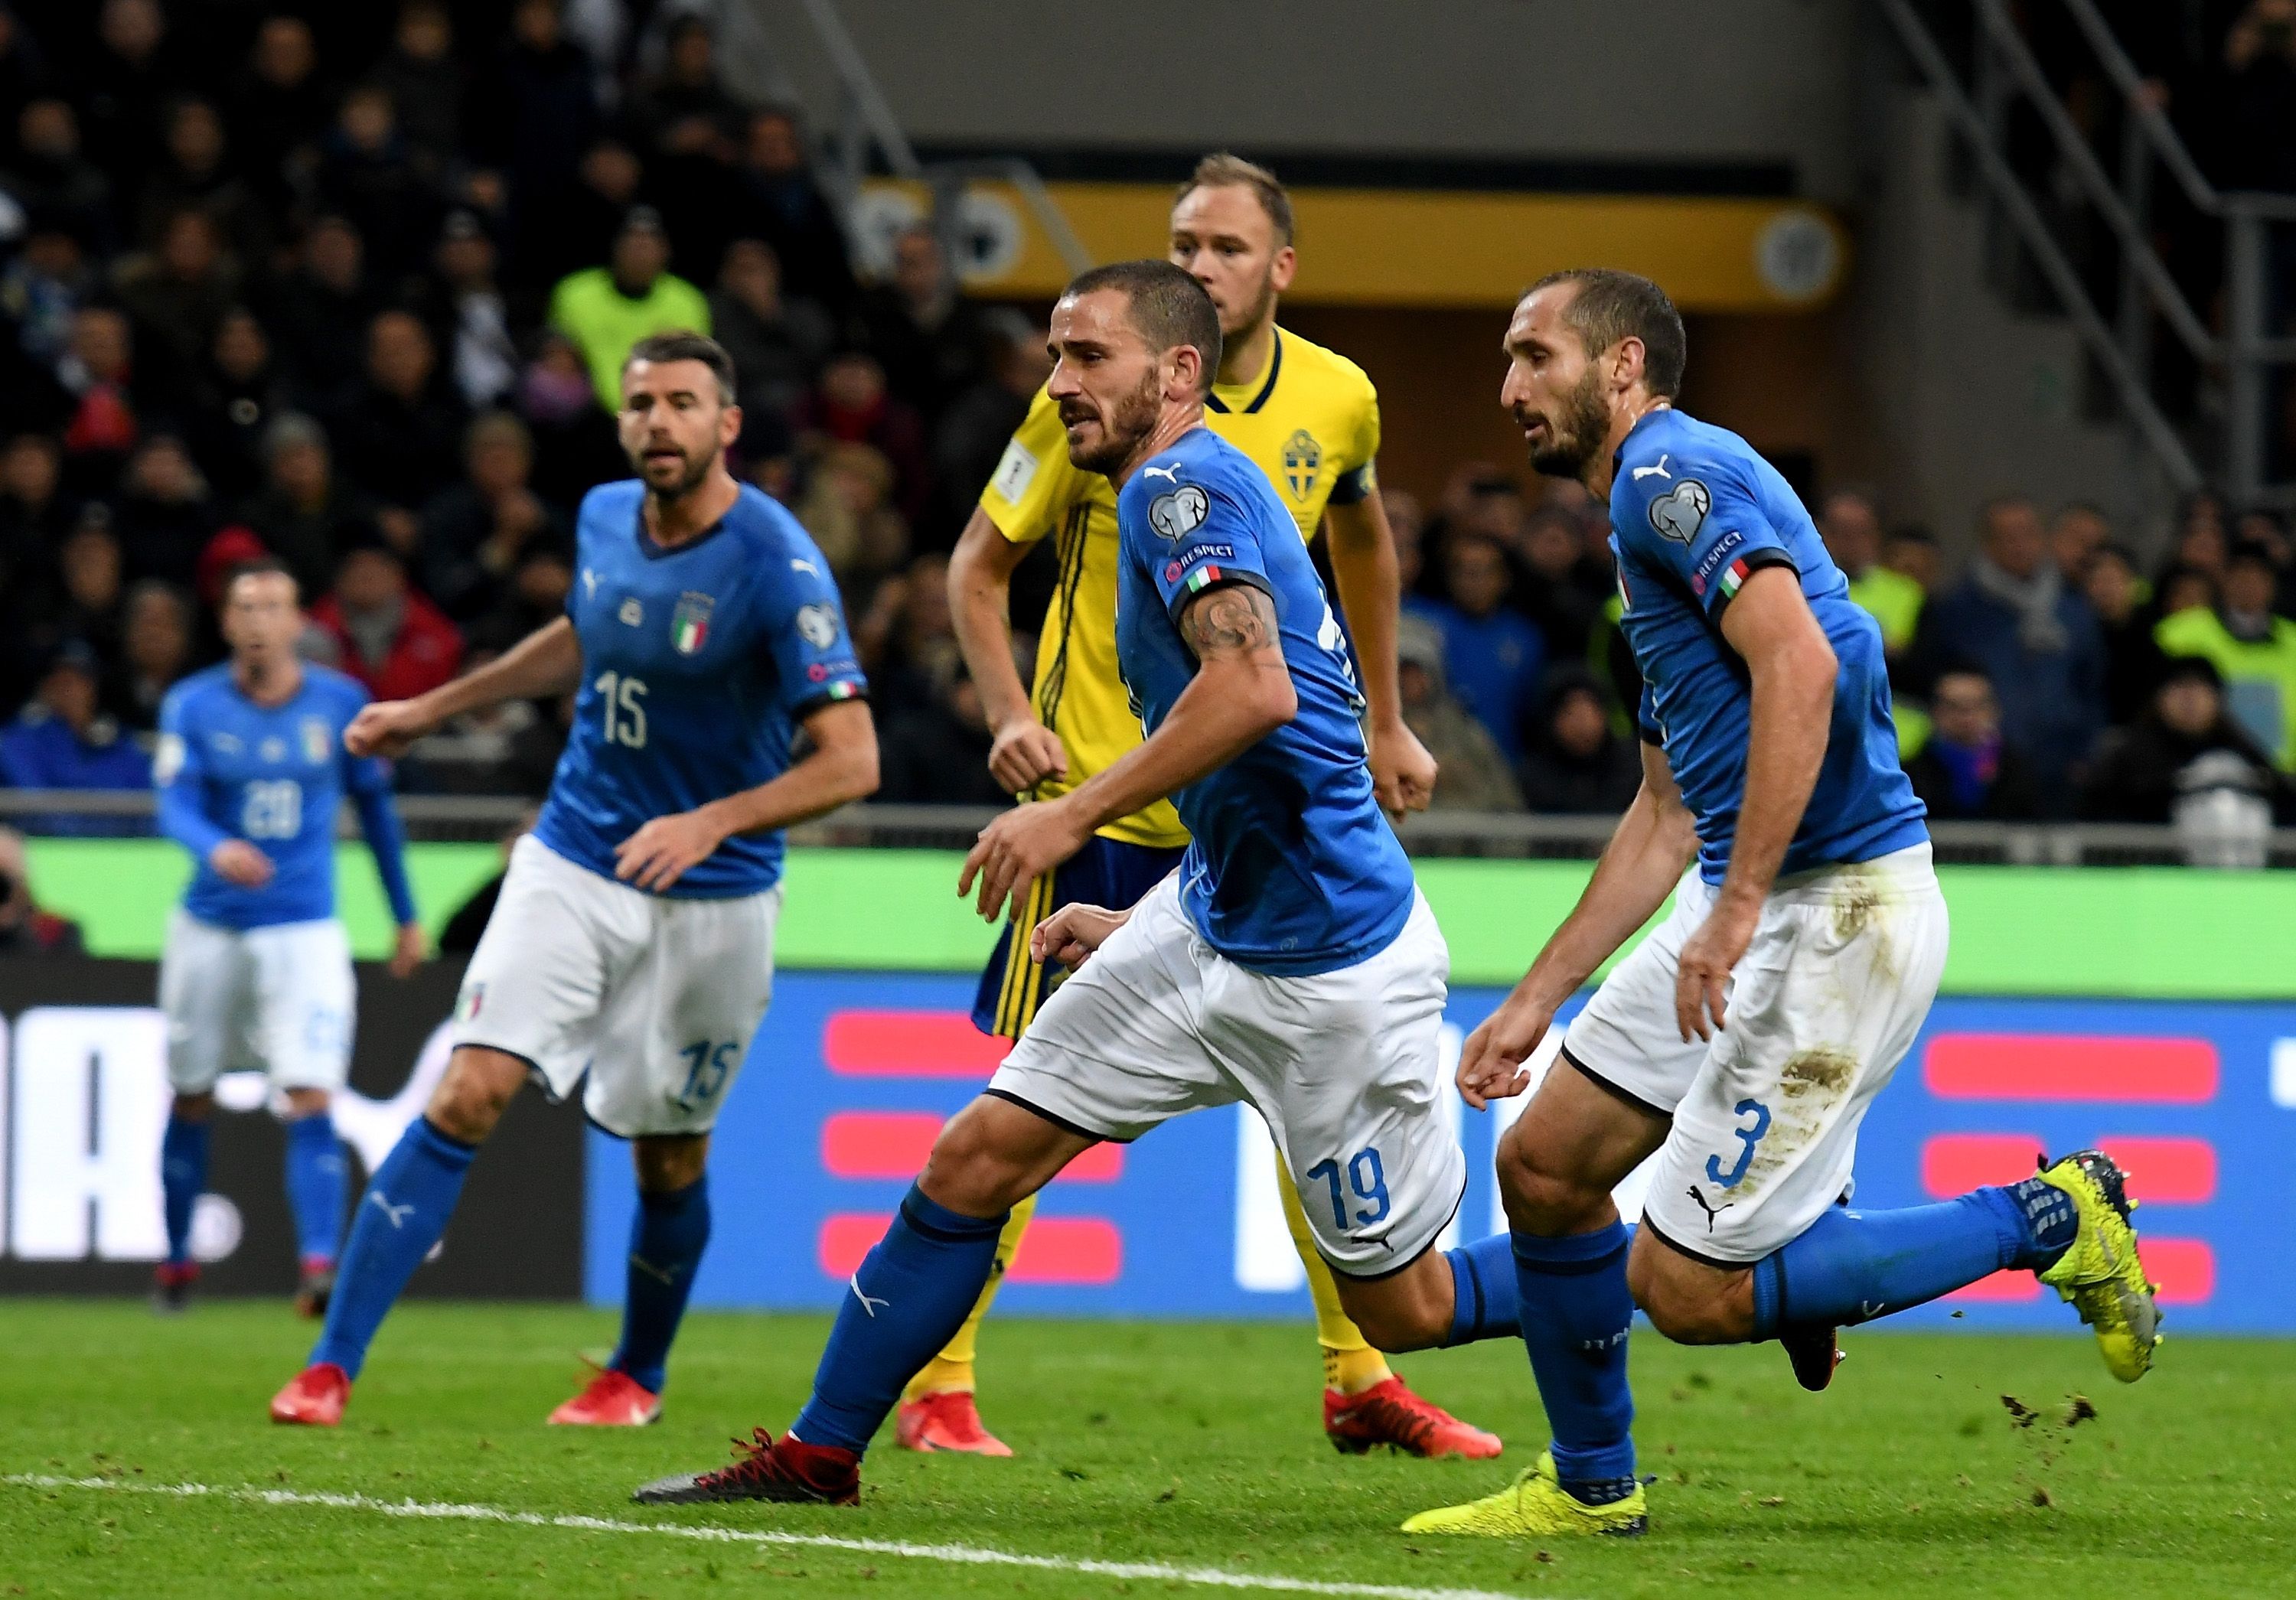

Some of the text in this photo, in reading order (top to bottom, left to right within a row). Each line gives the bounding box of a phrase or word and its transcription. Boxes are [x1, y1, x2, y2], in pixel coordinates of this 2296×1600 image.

[1180, 544, 1232, 568] RESPECT
[1698, 531, 1742, 578] RESPECT
[595, 670, 649, 749] 15
[241, 780, 304, 839] 20
[679, 1040, 739, 1100] 15
[1705, 1098, 1772, 1188] 3
[1306, 1146, 1391, 1230] 19
